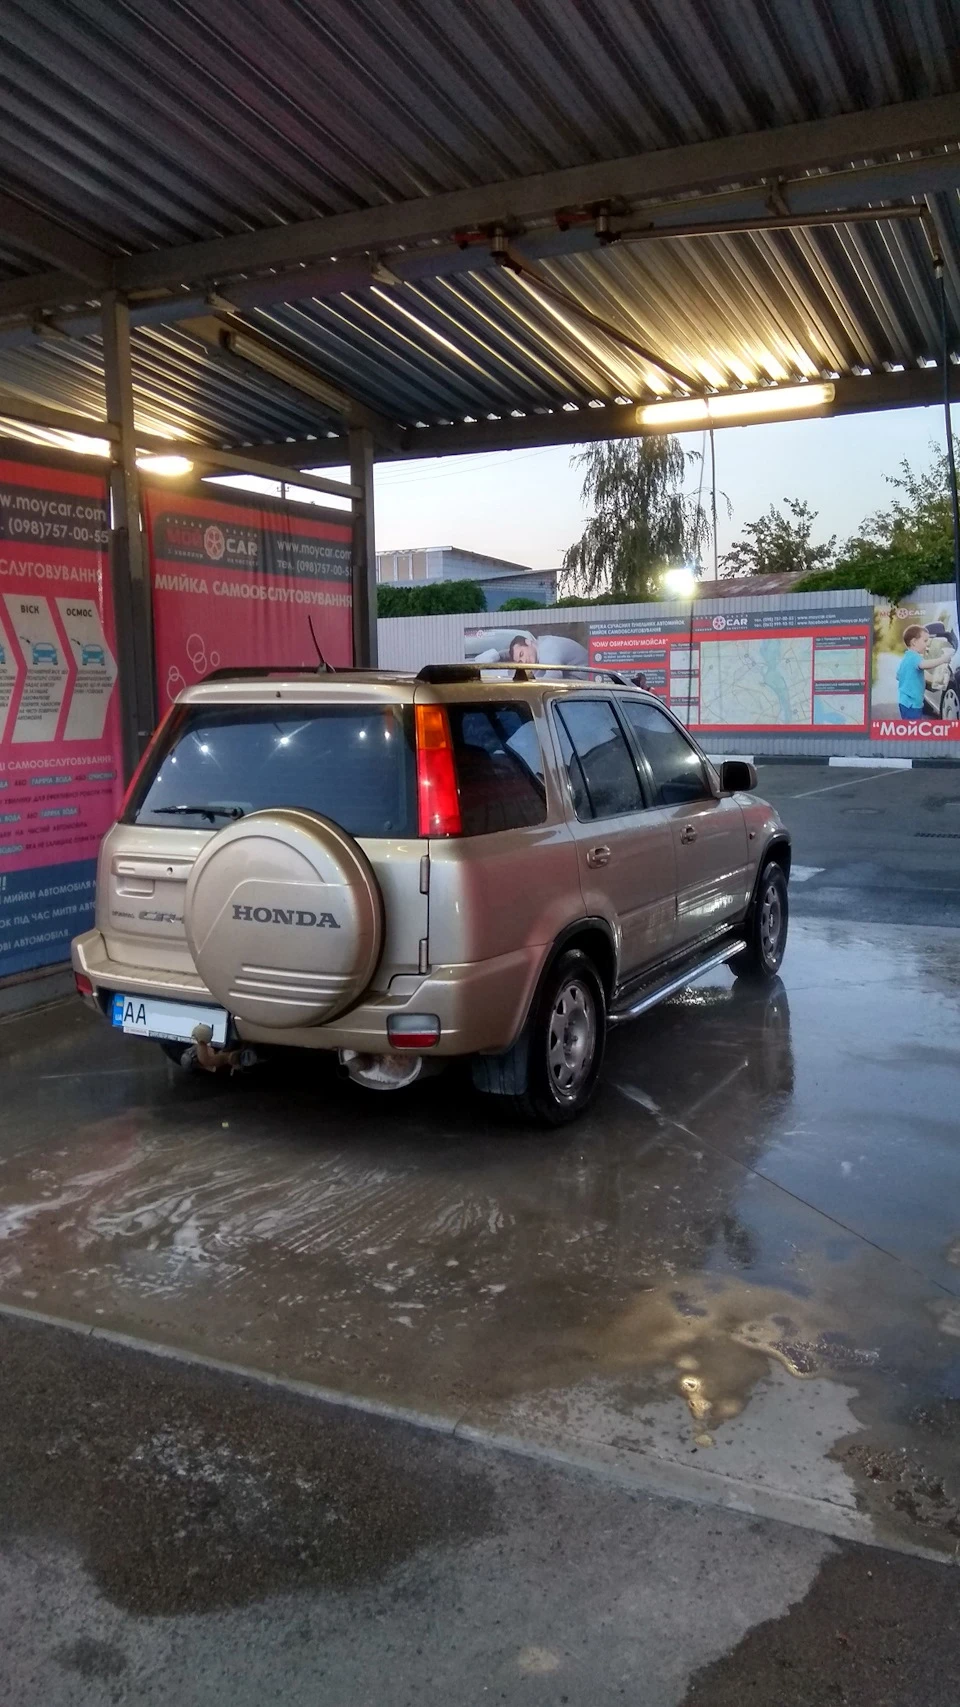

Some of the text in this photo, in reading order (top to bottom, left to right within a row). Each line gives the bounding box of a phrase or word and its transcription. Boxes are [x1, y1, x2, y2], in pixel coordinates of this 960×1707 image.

[8, 517, 110, 543] (098)757-00-55
[226, 538, 258, 556] CAR
[154, 573, 352, 607] МИЙКА САМООБСЛУГОВУВАННЯ
[66, 608, 93, 617] ОСМОС
[726, 618, 748, 626] CAR
[3, 891, 36, 904] МИЙКИ
[38, 881, 91, 898] АВТОМОБІЛЯ
[13, 915, 30, 925] ПІД
[31, 911, 50, 920] ЧАС
[232, 905, 341, 928] HONDA
